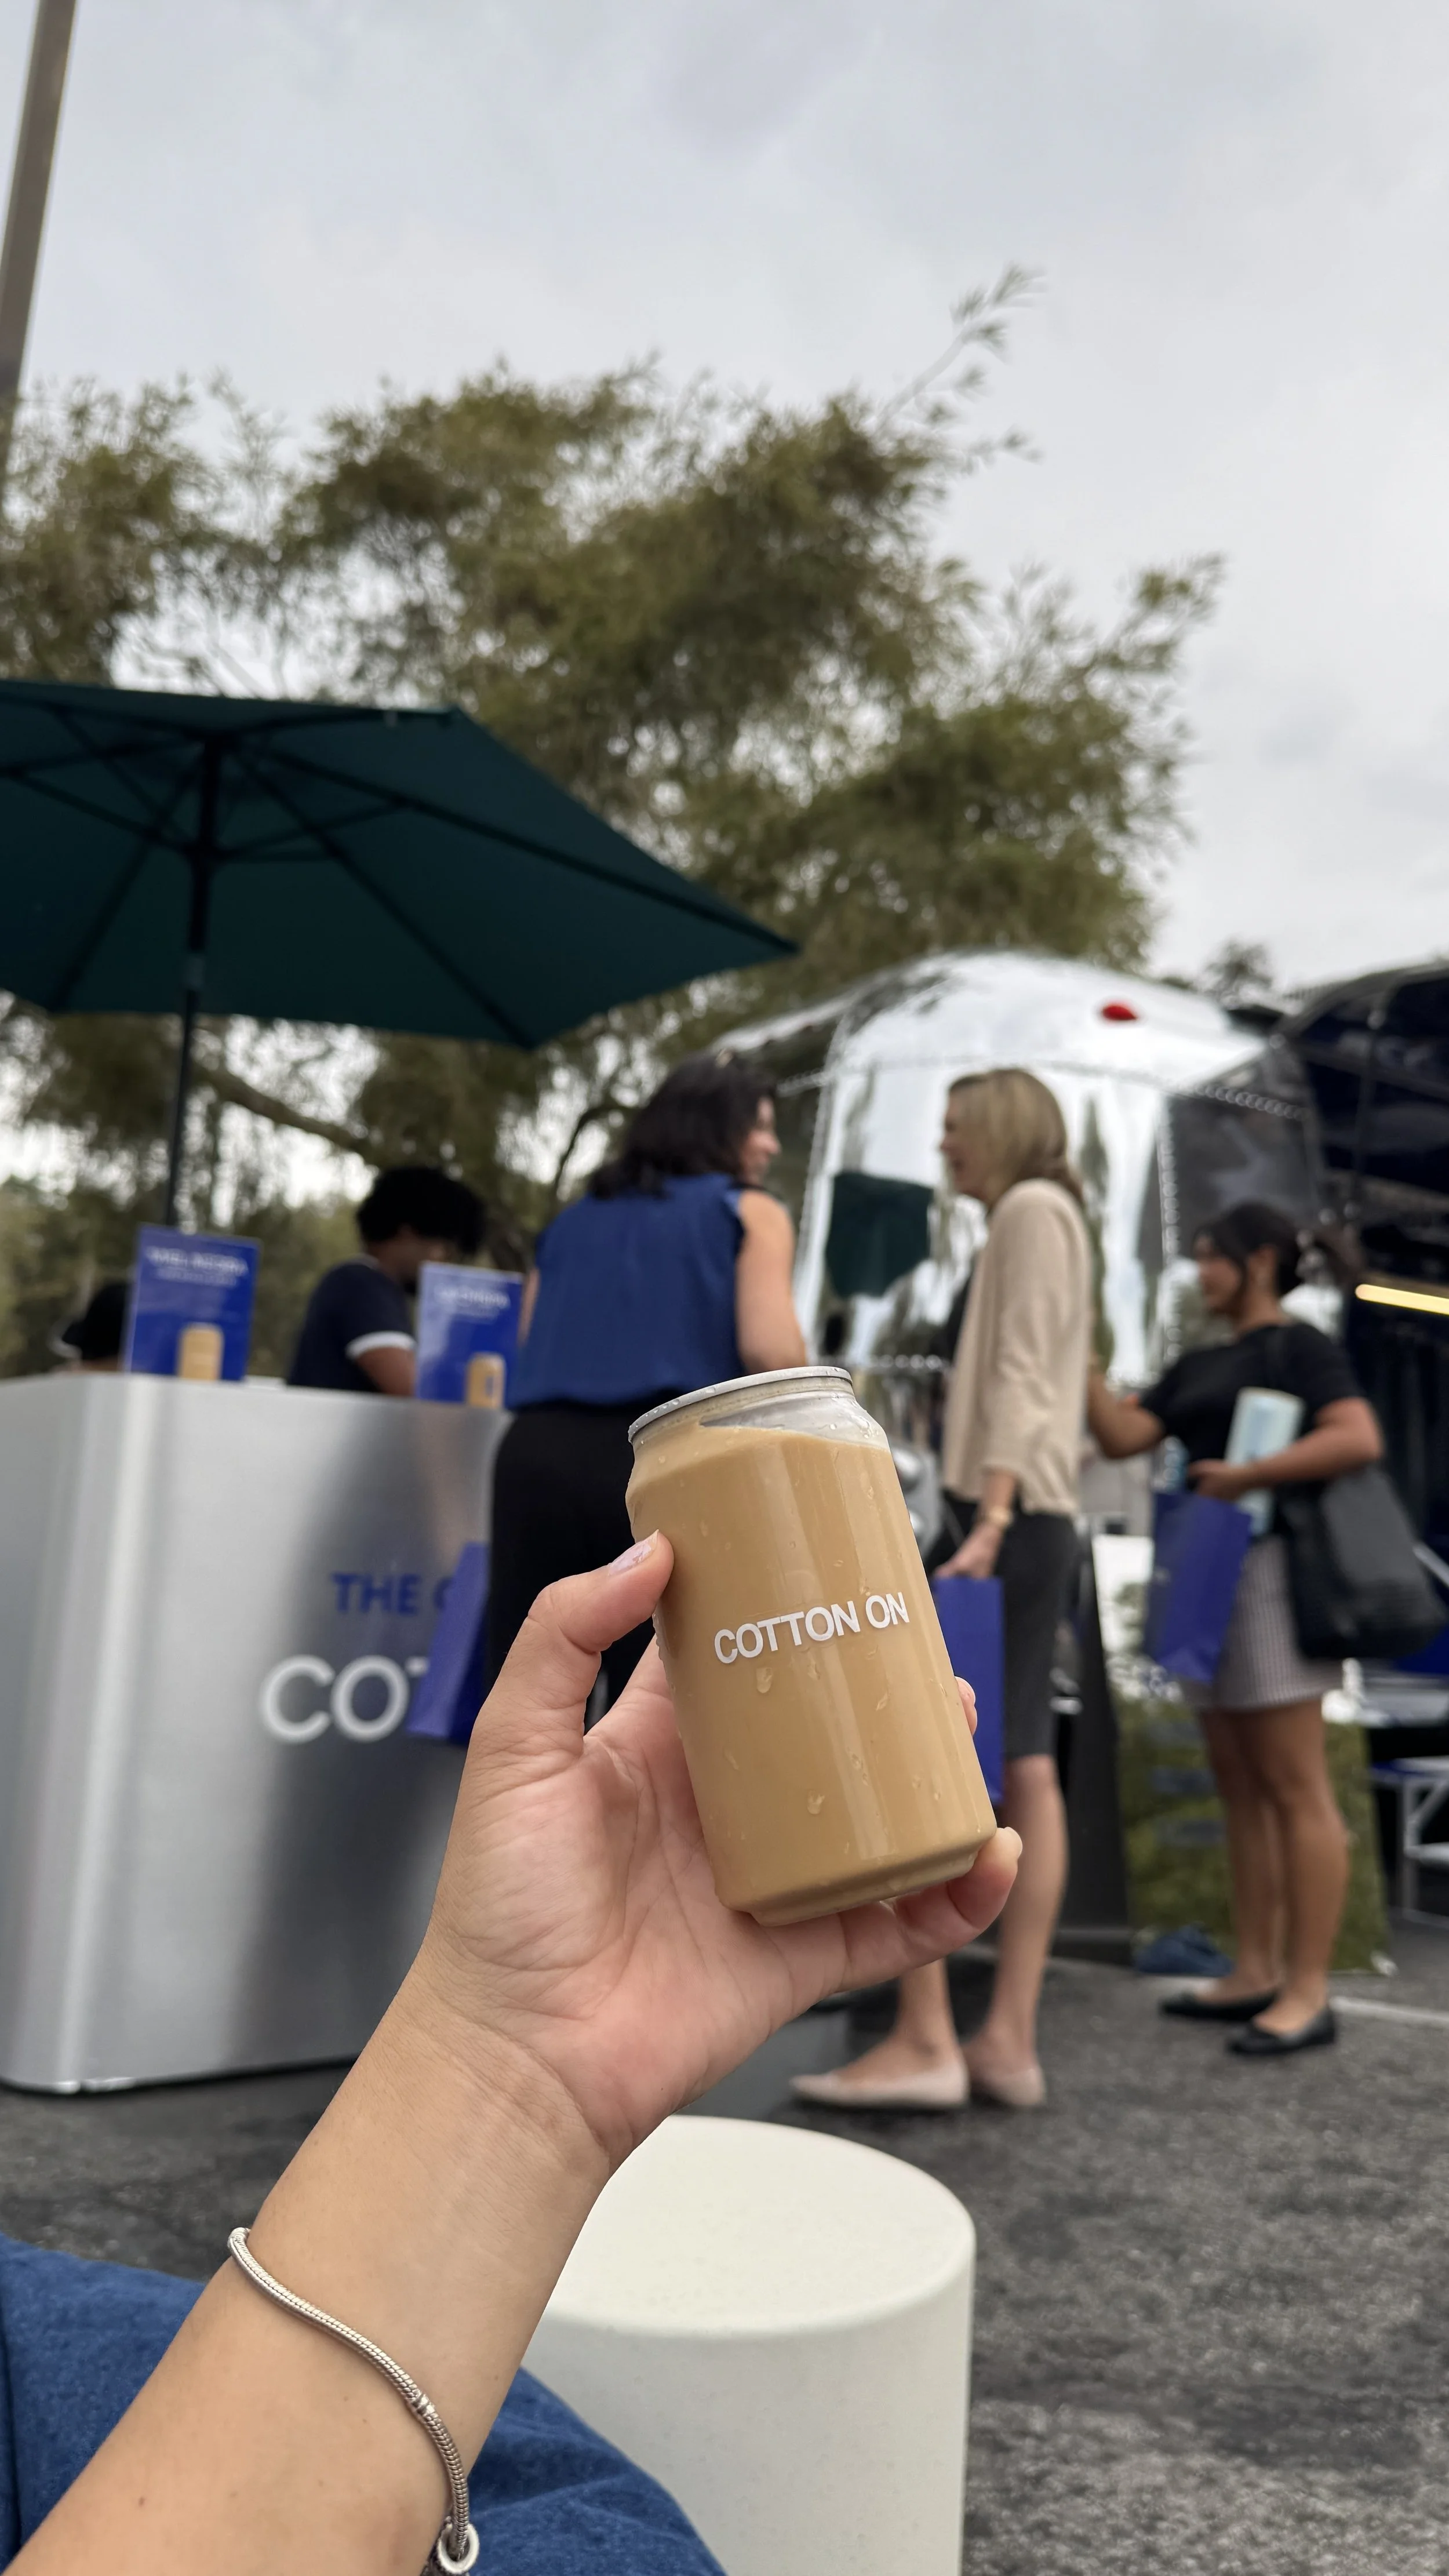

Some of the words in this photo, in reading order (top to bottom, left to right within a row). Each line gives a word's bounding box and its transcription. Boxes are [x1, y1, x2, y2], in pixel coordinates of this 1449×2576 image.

[332, 1573, 421, 1616] THE
[714, 1601, 861, 1664] COTTON
[865, 1592, 910, 1629] ON
[261, 1654, 429, 1742] CO
